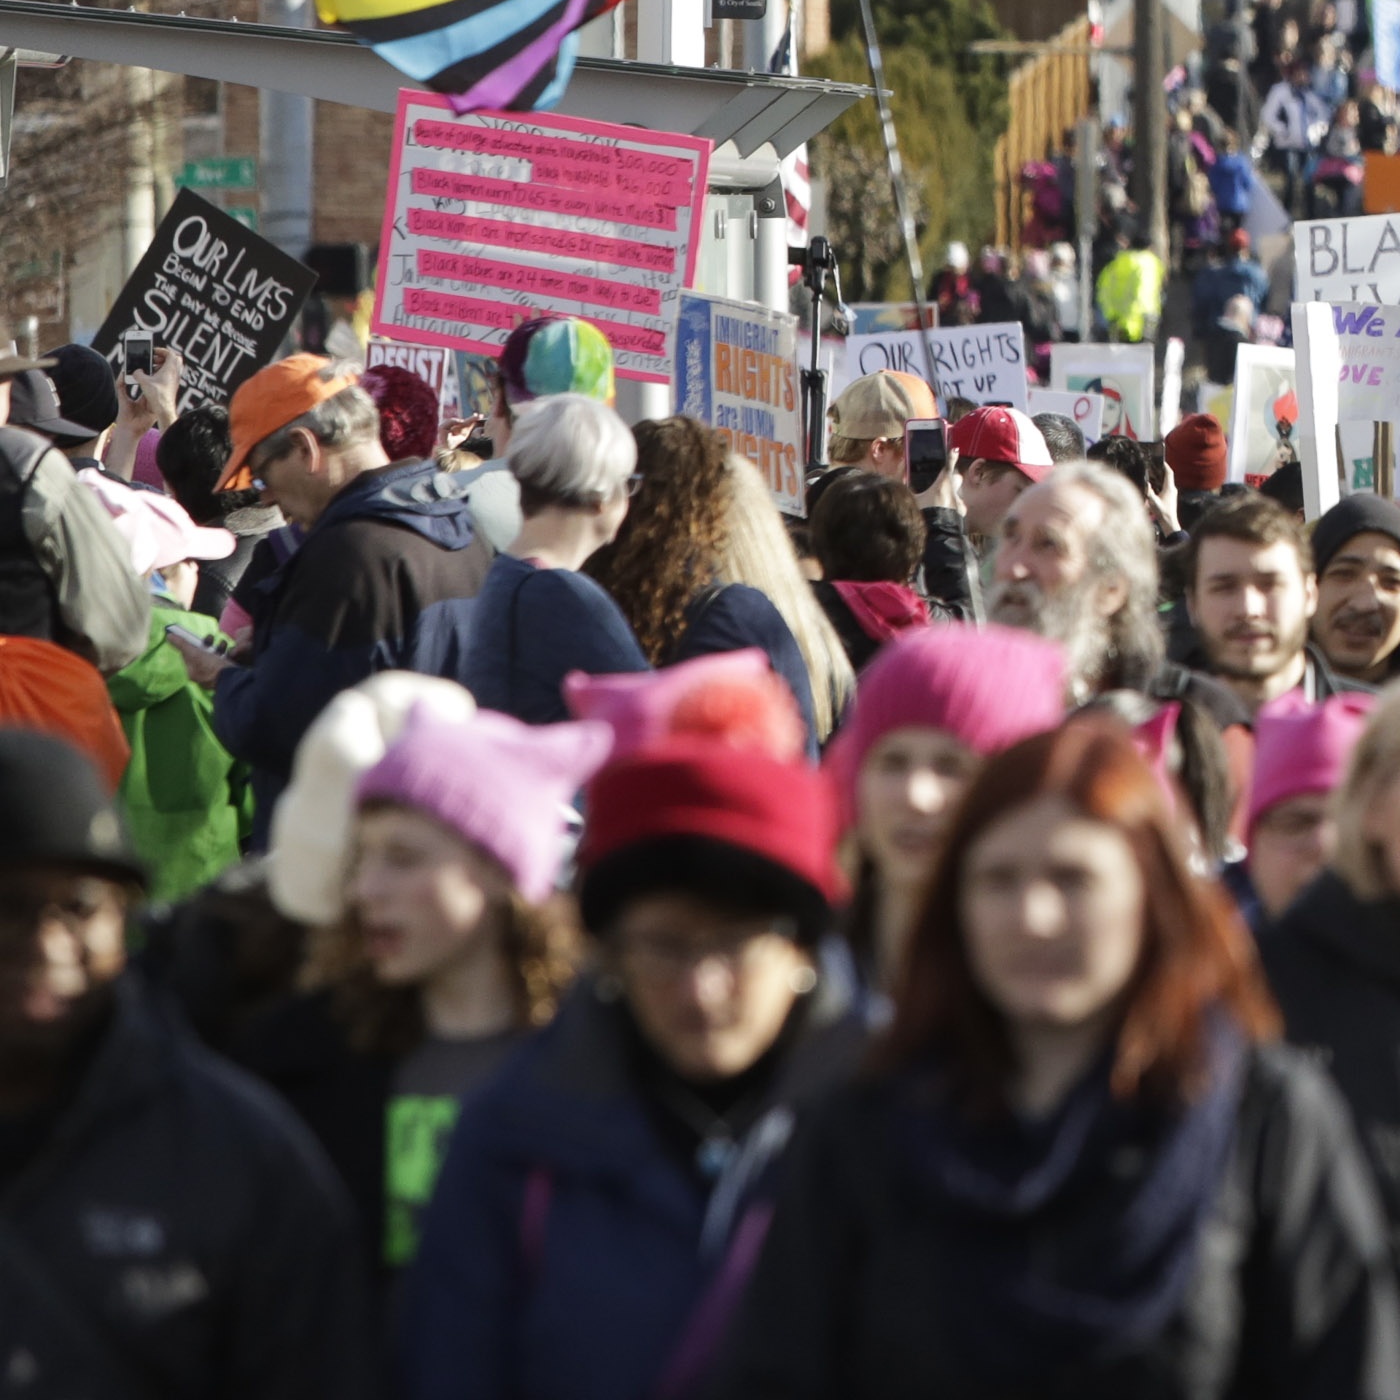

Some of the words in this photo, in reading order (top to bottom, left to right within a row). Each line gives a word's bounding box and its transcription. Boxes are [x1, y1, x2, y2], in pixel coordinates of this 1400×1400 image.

[173, 215, 229, 277] OUR
[222, 247, 294, 321] LIVES
[133, 288, 256, 384] SILENT
[230, 300, 265, 331] END
[715, 314, 779, 357] IMMIGRANT
[1331, 305, 1386, 338] We
[859, 341, 922, 376] OUR
[931, 332, 1020, 373] RIGHTS
[715, 341, 795, 412] RIGHTS
[974, 373, 997, 393] UP
